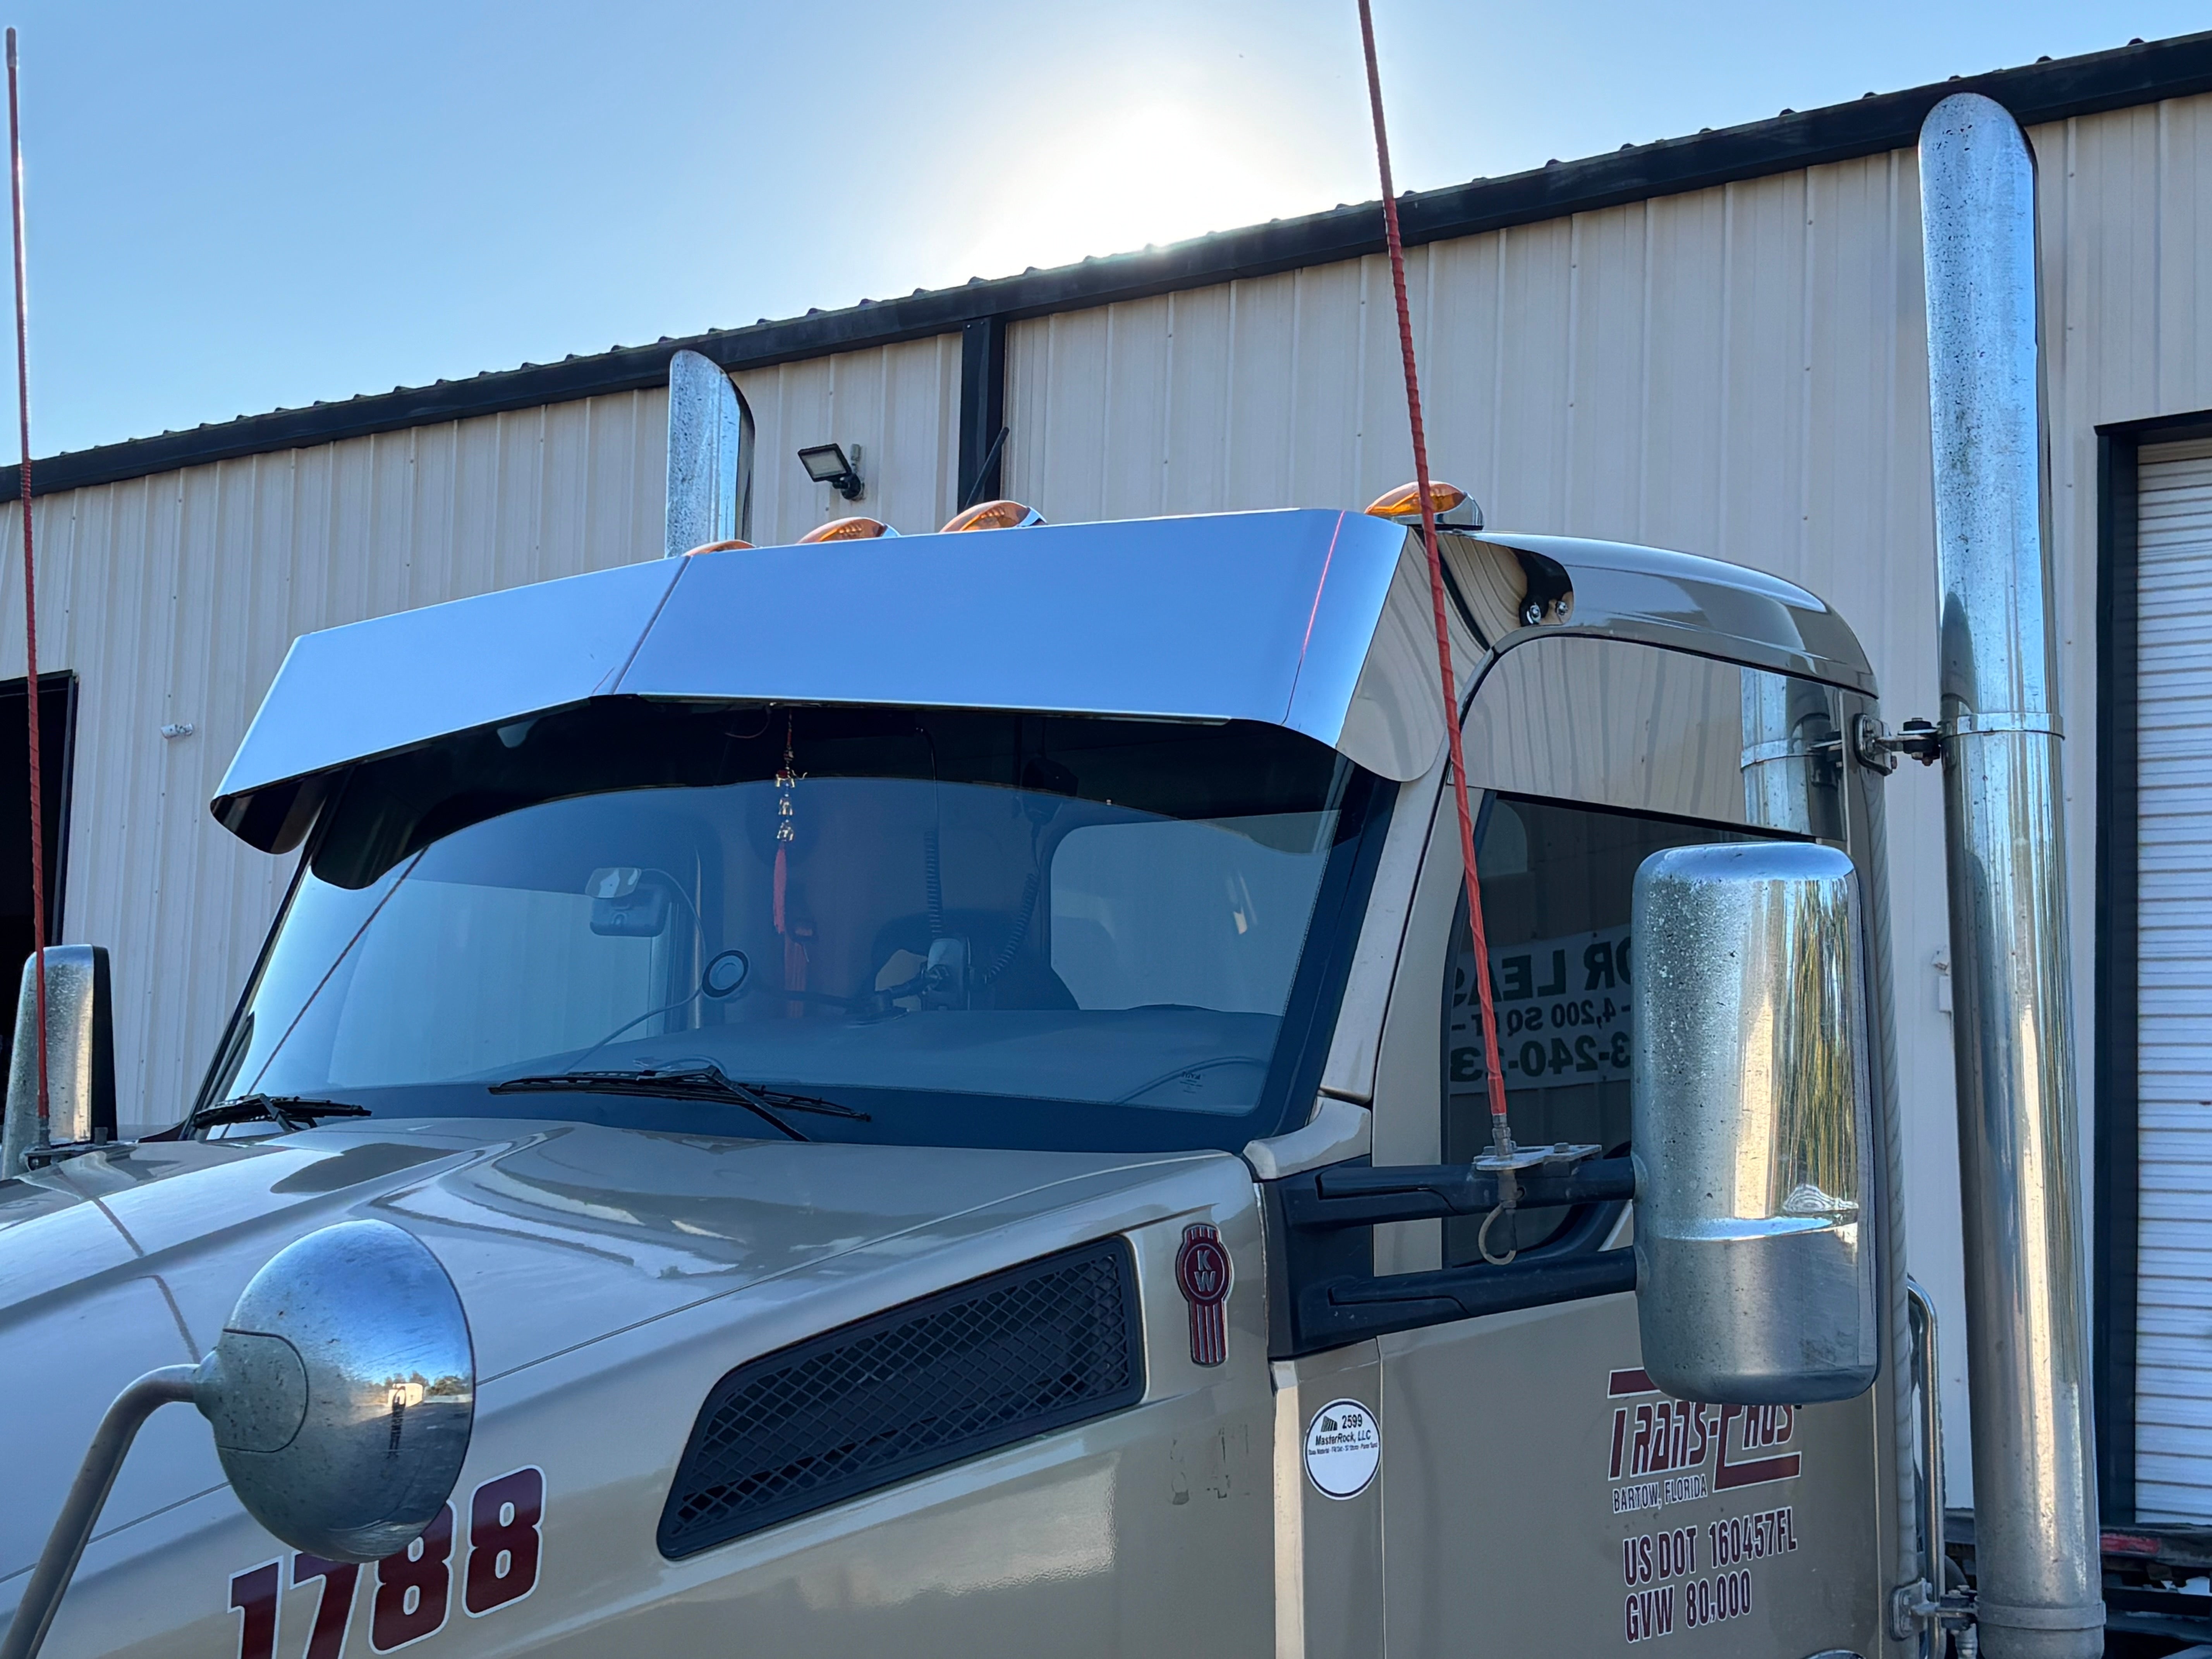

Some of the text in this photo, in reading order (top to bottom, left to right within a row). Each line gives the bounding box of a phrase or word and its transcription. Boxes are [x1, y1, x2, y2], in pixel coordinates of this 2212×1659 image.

[1316, 1429, 1371, 1446] MasterRock, LLC
[1342, 1413, 1363, 1429] 2599
[1613, 1473, 1708, 1514] BARTOW, FLORIDA
[227, 1464, 547, 1659] 1788
[1623, 1506, 1798, 1587] US DOT 160457FL
[1626, 1568, 1752, 1644] GVW 80,000
